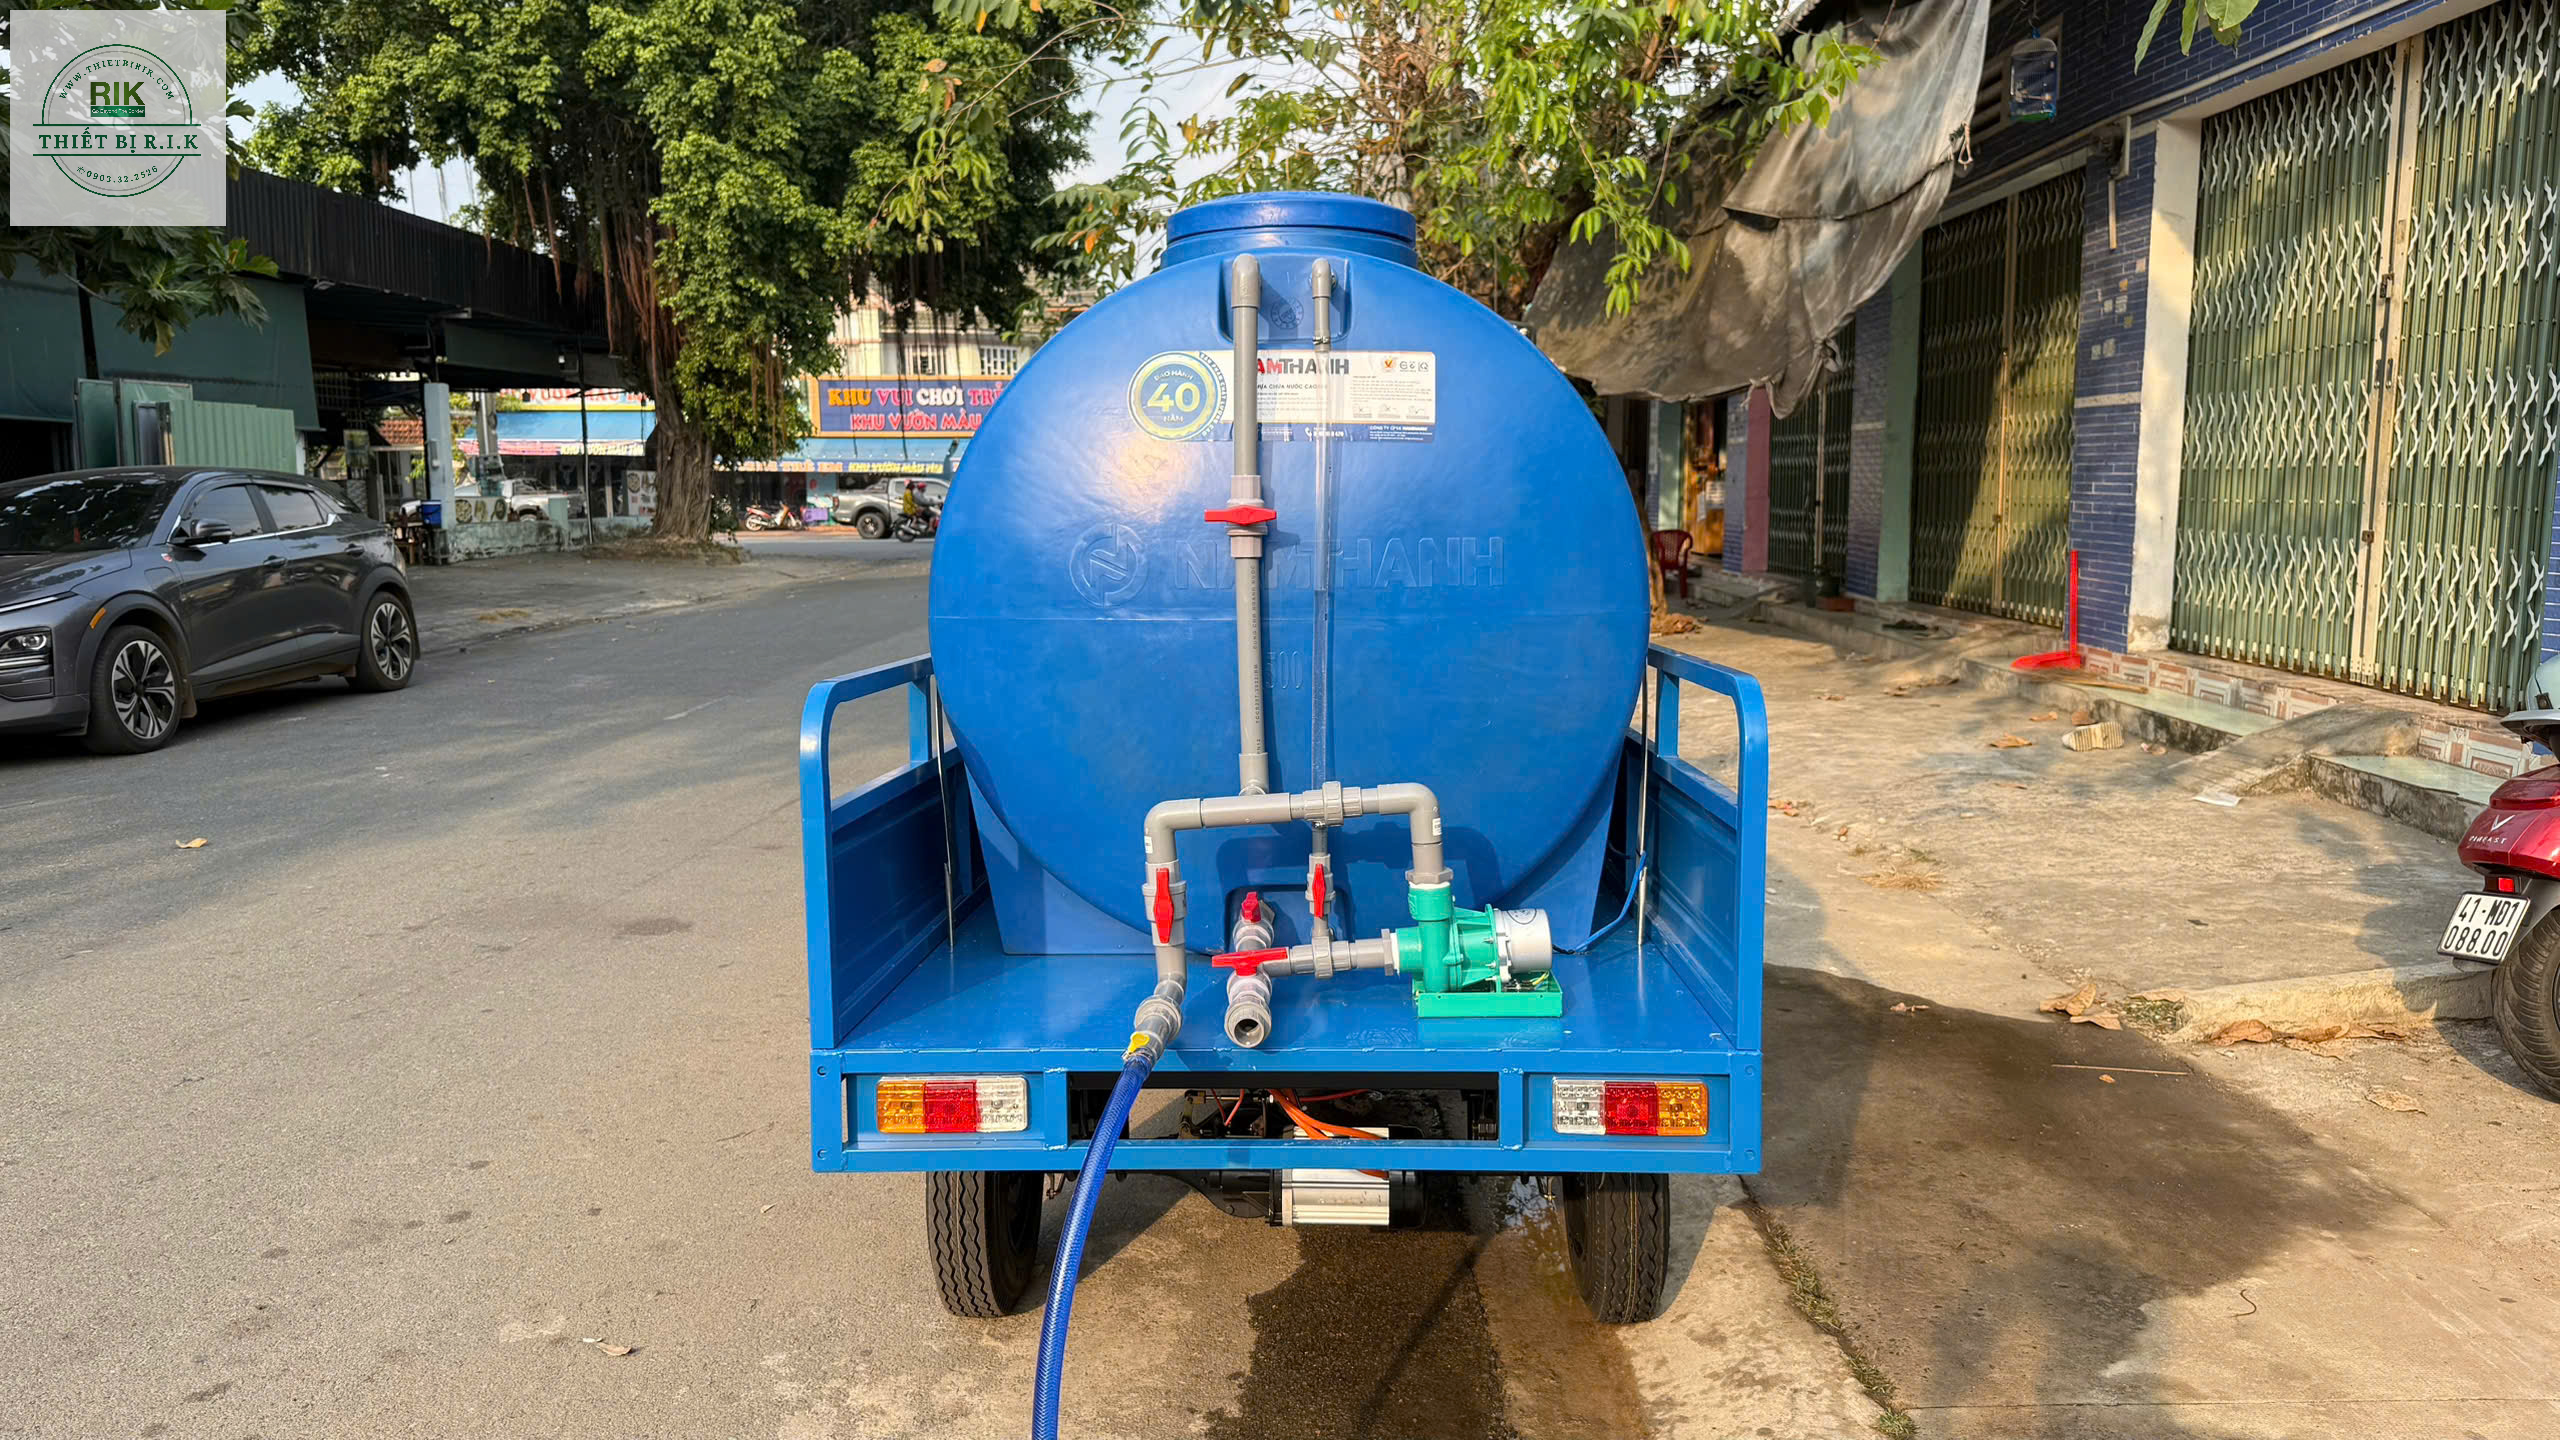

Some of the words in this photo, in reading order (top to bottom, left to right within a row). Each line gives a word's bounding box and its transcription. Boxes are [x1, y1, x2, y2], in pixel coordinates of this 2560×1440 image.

[827, 388, 873, 407] KHU
[875, 388, 914, 407] VUI
[916, 385, 965, 407] CHƠI
[1146, 382, 1201, 414] 40
[850, 413, 886, 431] KHU
[1174, 536, 1507, 590] NMTHANH
[2443, 924, 2509, 958] 088.00
